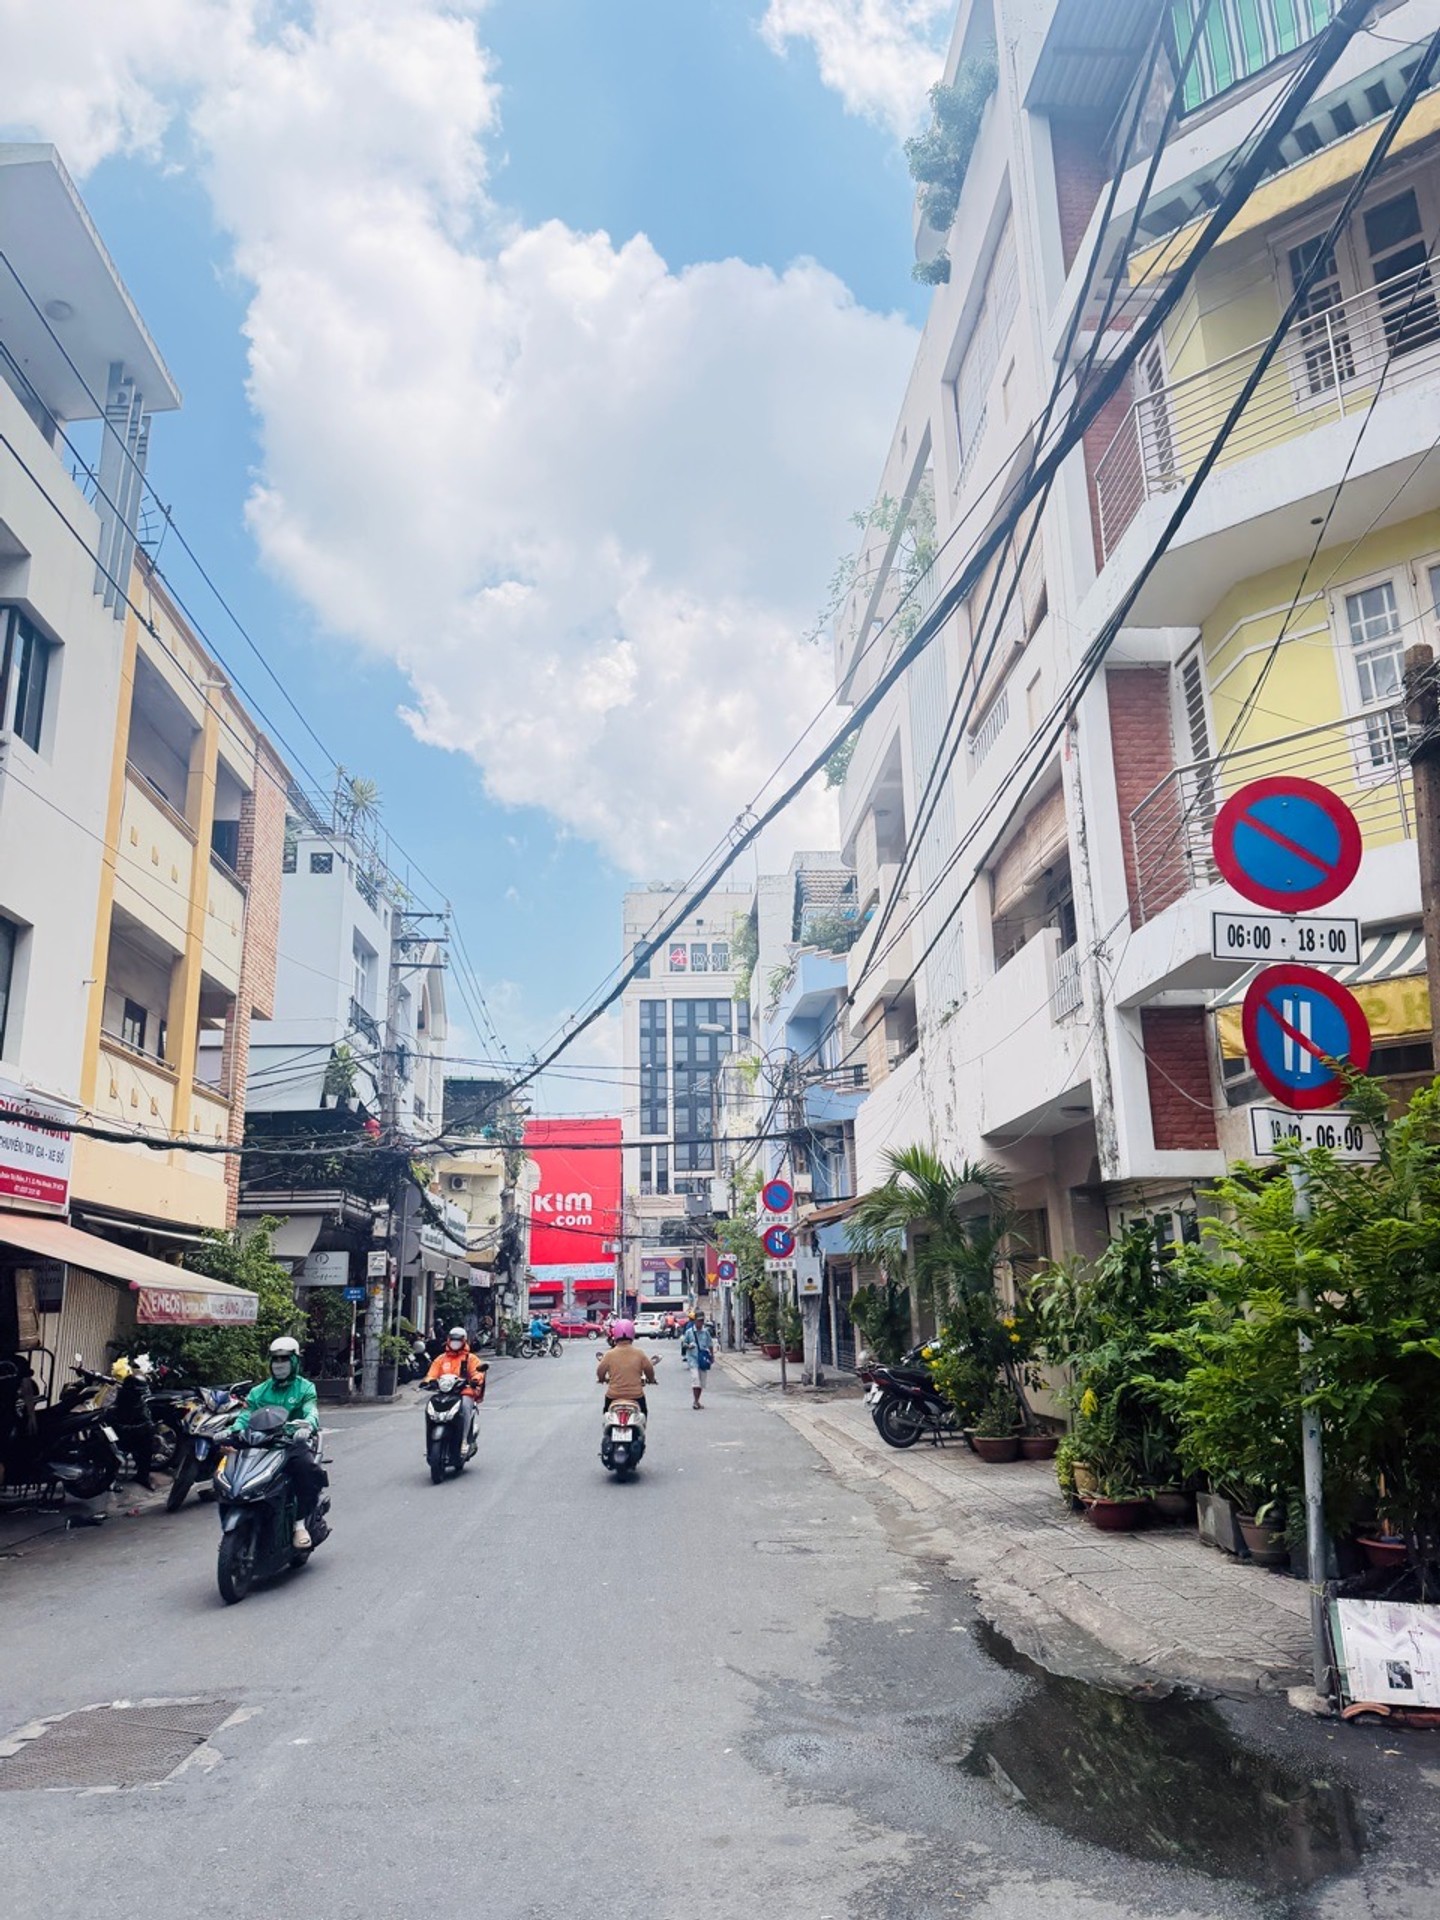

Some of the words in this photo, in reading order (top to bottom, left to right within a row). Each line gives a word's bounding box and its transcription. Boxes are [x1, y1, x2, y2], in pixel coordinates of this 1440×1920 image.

[1227, 924, 1271, 949] 06:00
[1298, 928, 1346, 953] 18:00
[1316, 1125, 1363, 1151] 06:00
